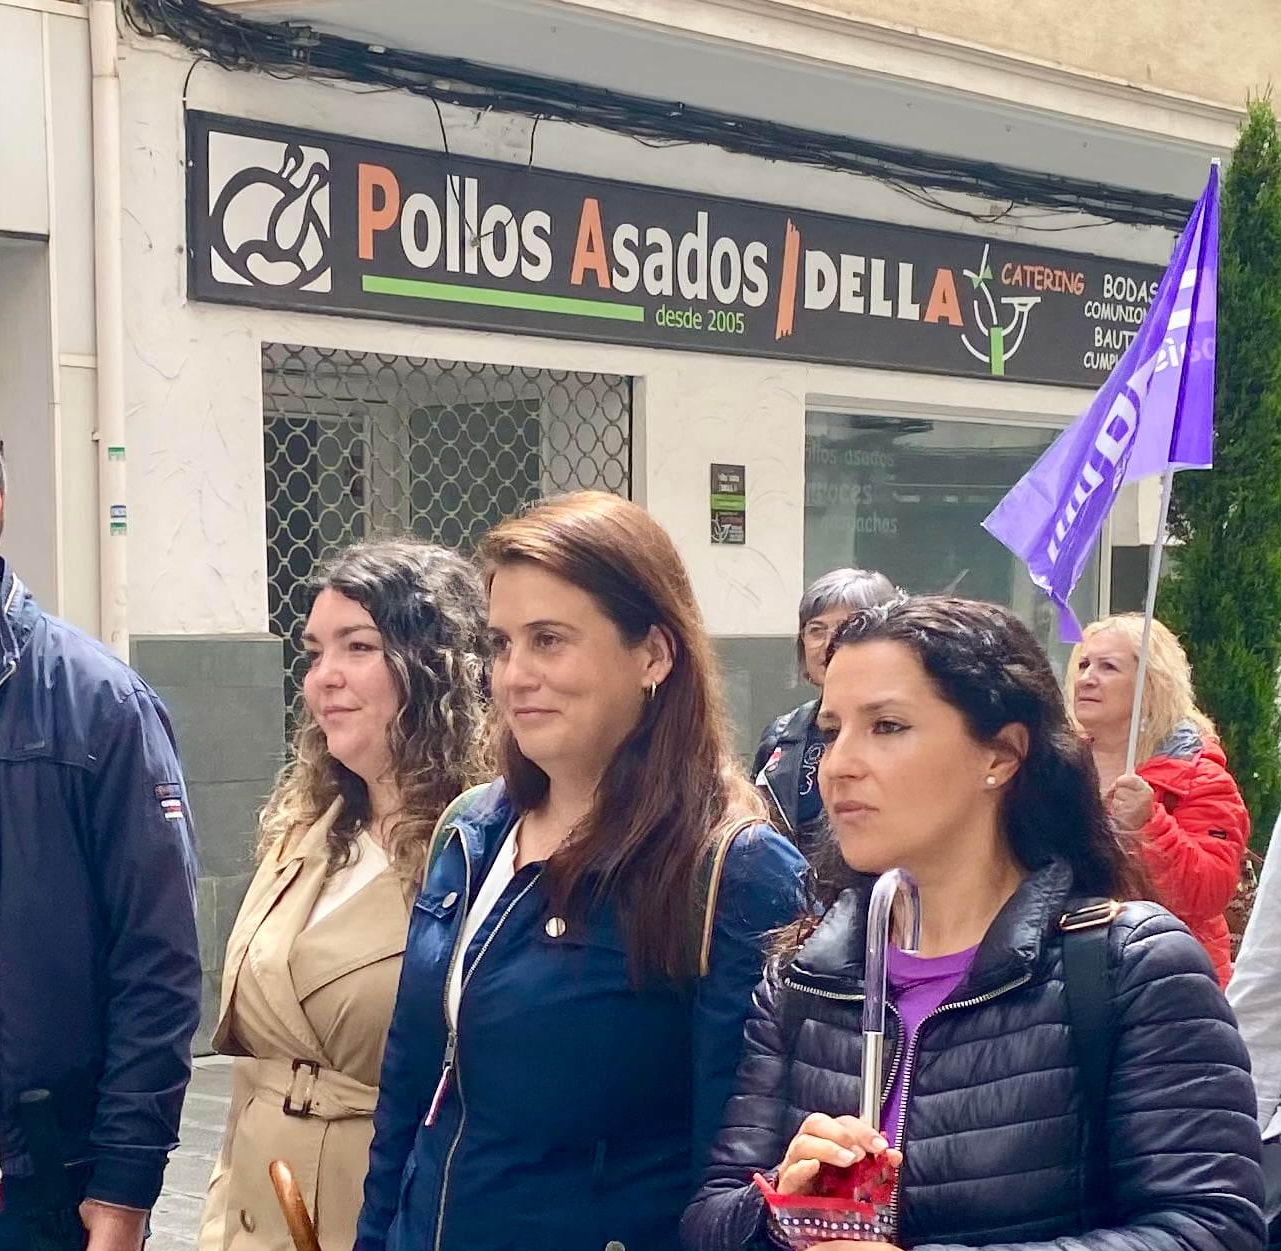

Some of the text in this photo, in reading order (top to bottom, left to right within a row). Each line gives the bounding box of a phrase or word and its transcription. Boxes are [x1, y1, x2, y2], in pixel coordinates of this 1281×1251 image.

[358, 163, 552, 282] Pollos
[570, 198, 769, 307] Asados
[1001, 262, 1085, 296] CATERING
[1104, 273, 1159, 303] BODAS
[655, 304, 745, 334] desde 2005
